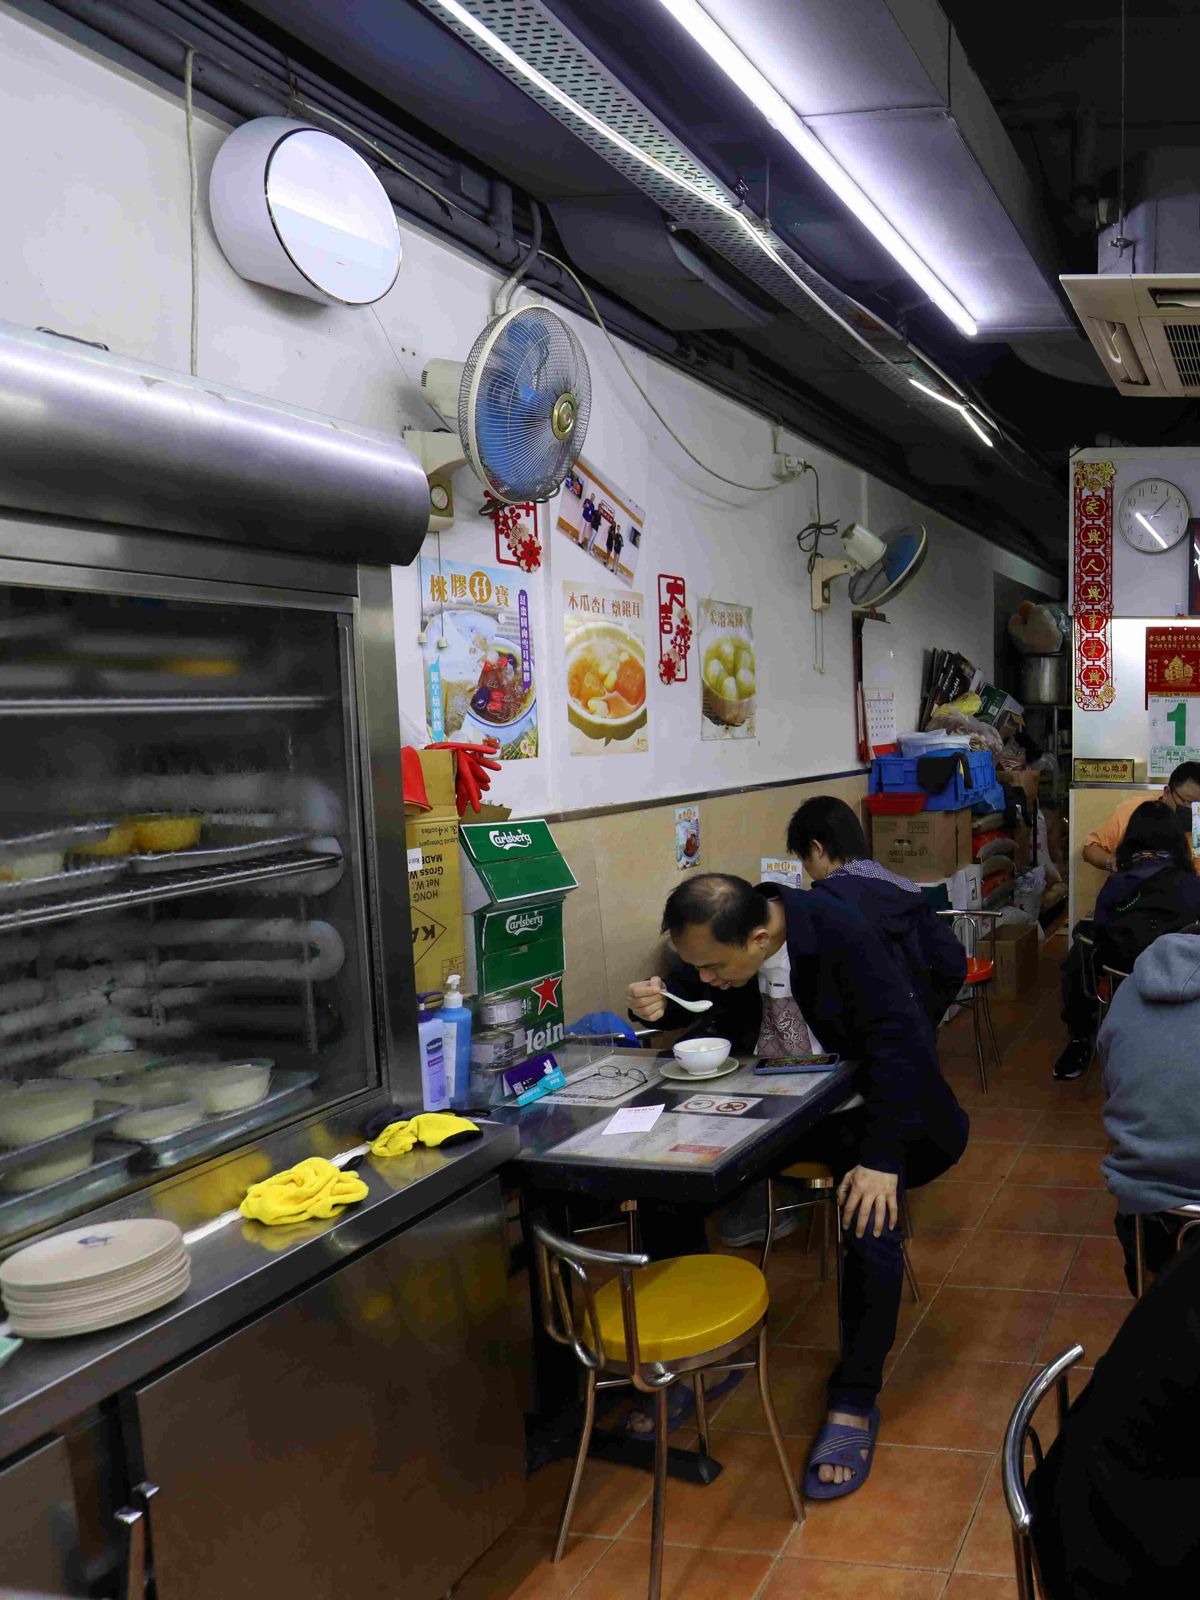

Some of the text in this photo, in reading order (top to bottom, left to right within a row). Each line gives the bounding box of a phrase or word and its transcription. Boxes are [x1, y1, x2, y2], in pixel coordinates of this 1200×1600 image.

[1139, 487, 1145, 497] 11
[1150, 484, 1158, 494] 12
[568, 591, 641, 618] 木瓜杏仁燉銀耳
[1166, 703, 1187, 746] 1
[1094, 763, 1128, 773] 小心地滑
[489, 829, 532, 850] Carlsberg
[420, 866, 444, 877] Gross
[426, 878, 440, 888] Net
[413, 889, 439, 902] HONG
[505, 910, 543, 936] Carlsberg
